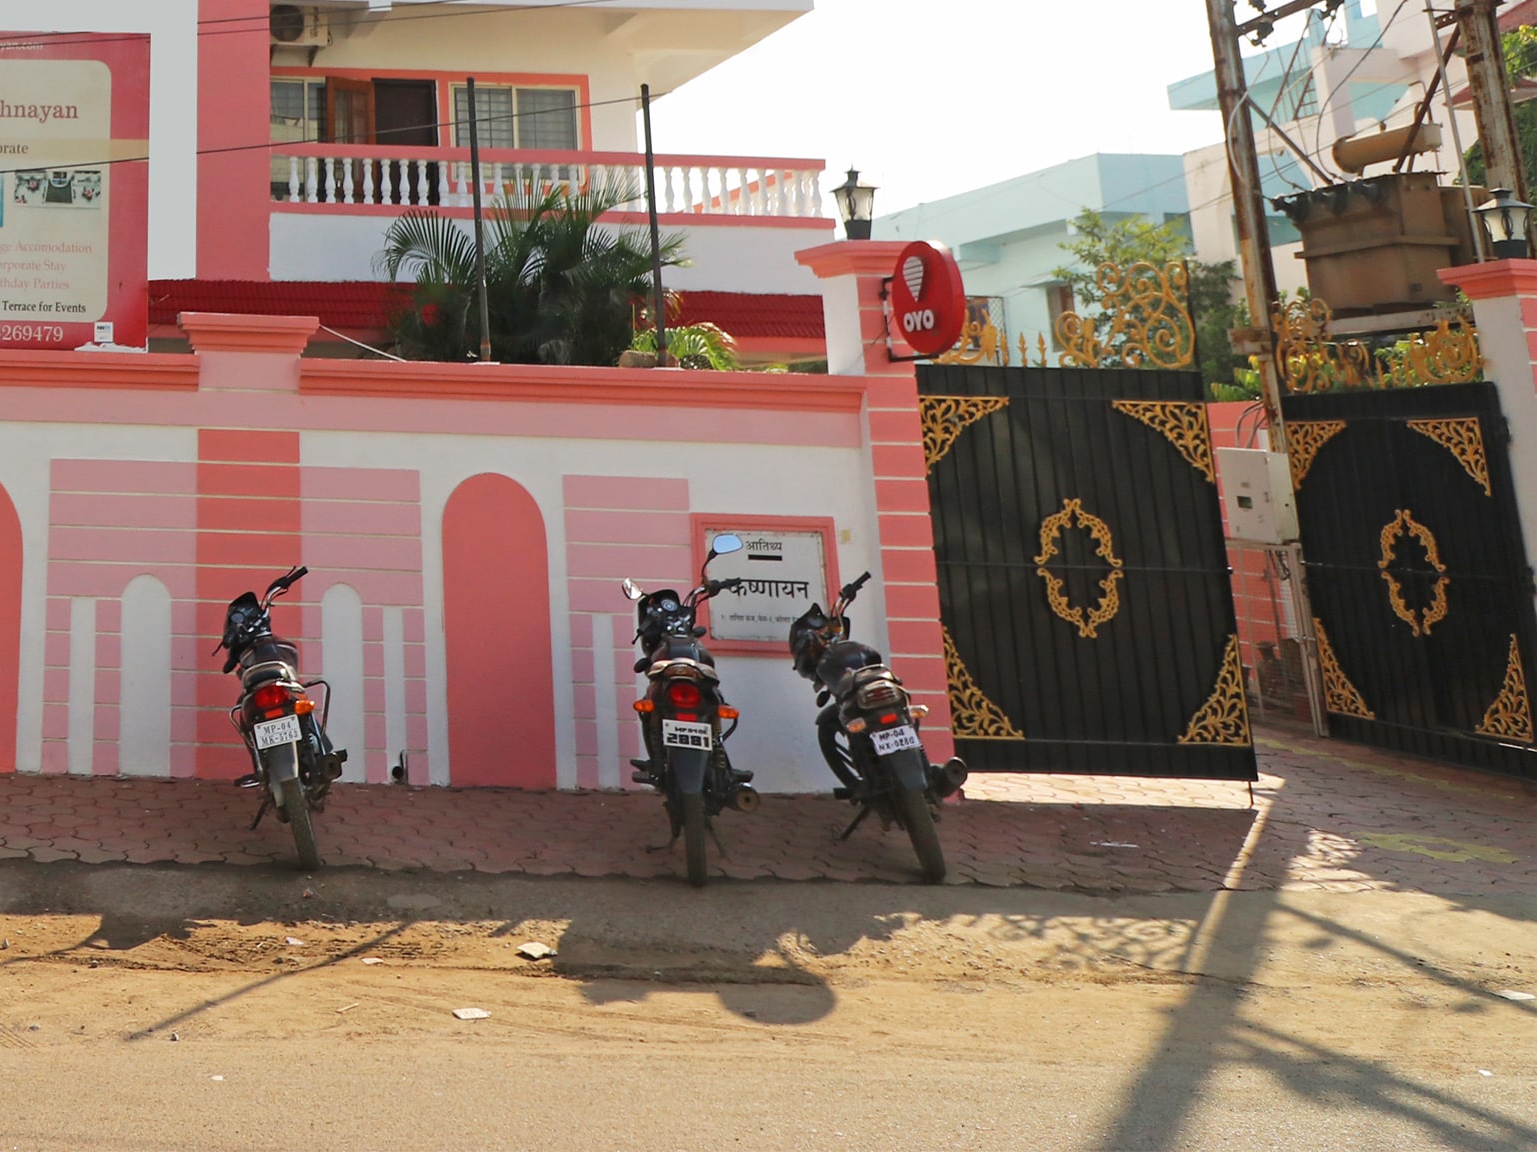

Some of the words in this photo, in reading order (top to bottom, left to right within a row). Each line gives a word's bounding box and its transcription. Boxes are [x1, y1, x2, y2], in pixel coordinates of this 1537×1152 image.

[17, 241, 93, 254] Accomodation
[44, 260, 67, 273] Stay
[32, 278, 70, 291] Parties
[2, 301, 35, 313] Terrace
[38, 301, 51, 313] for
[54, 302, 87, 314] Events
[903, 309, 935, 333] OYO
